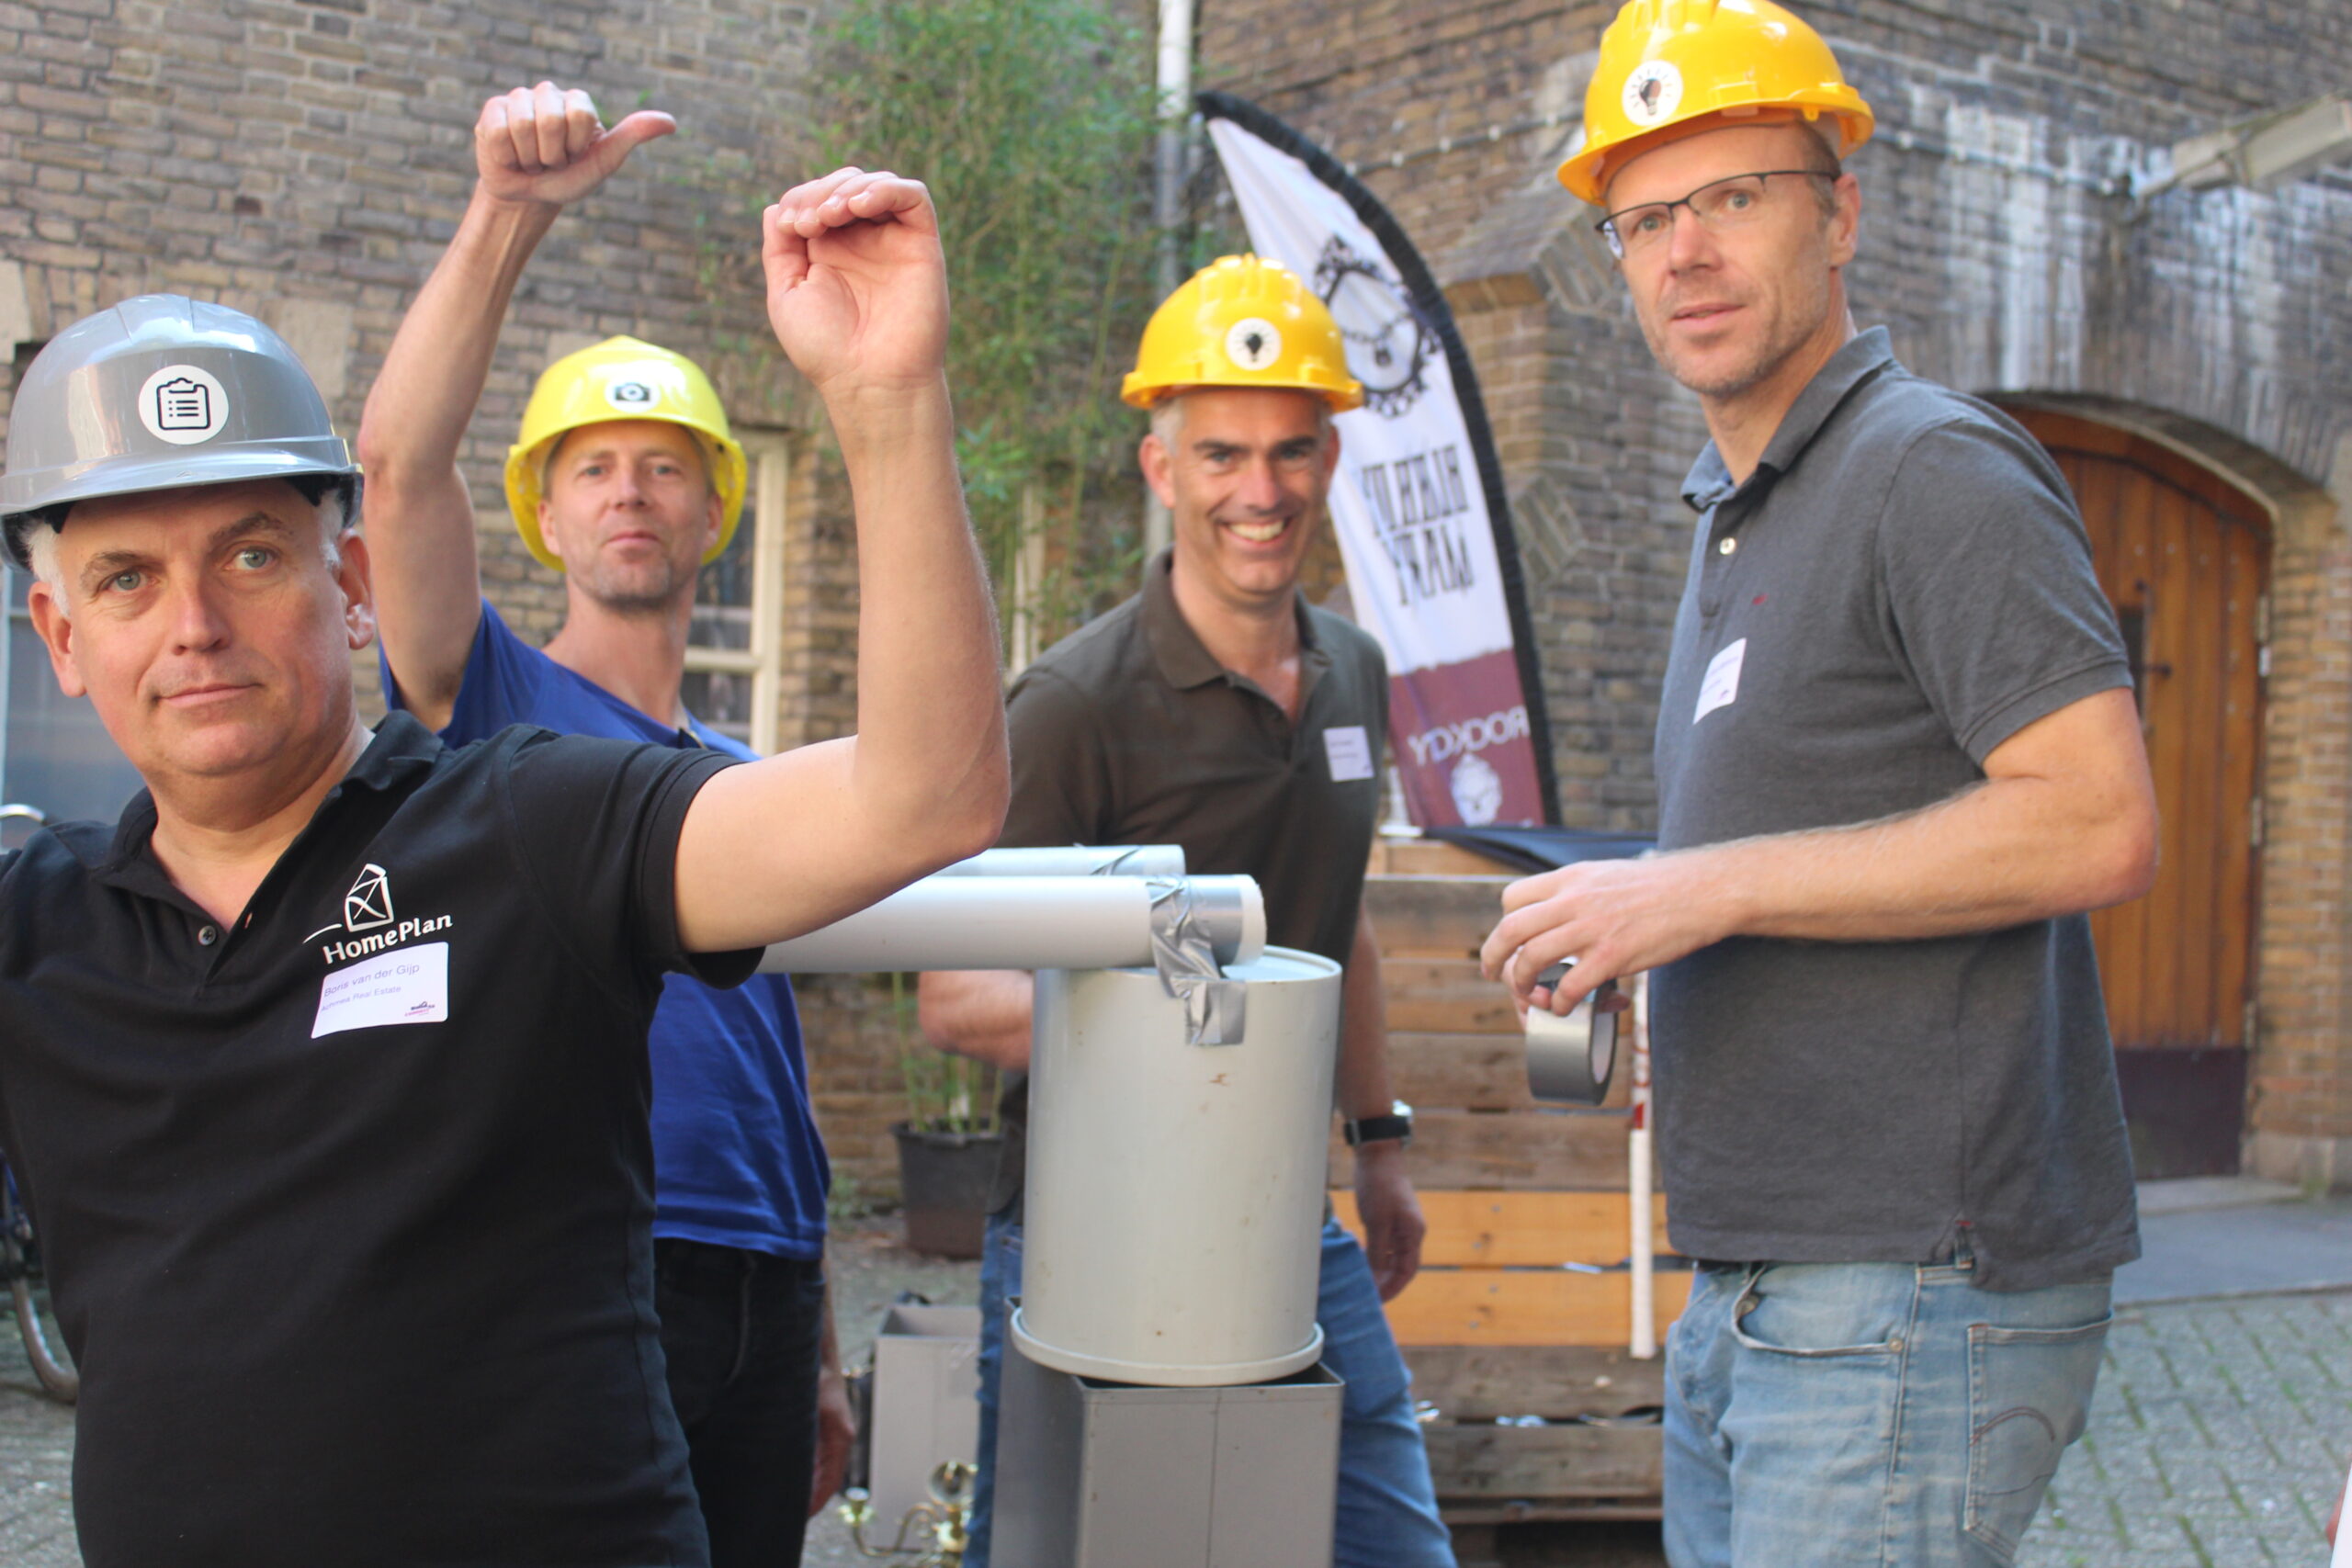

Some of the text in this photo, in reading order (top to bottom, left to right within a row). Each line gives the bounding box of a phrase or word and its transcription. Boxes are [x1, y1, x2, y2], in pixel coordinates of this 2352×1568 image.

[322, 914, 454, 964] HomePlan
[323, 964, 420, 998] Boris van der Gijp
[374, 985, 401, 997] Estate
